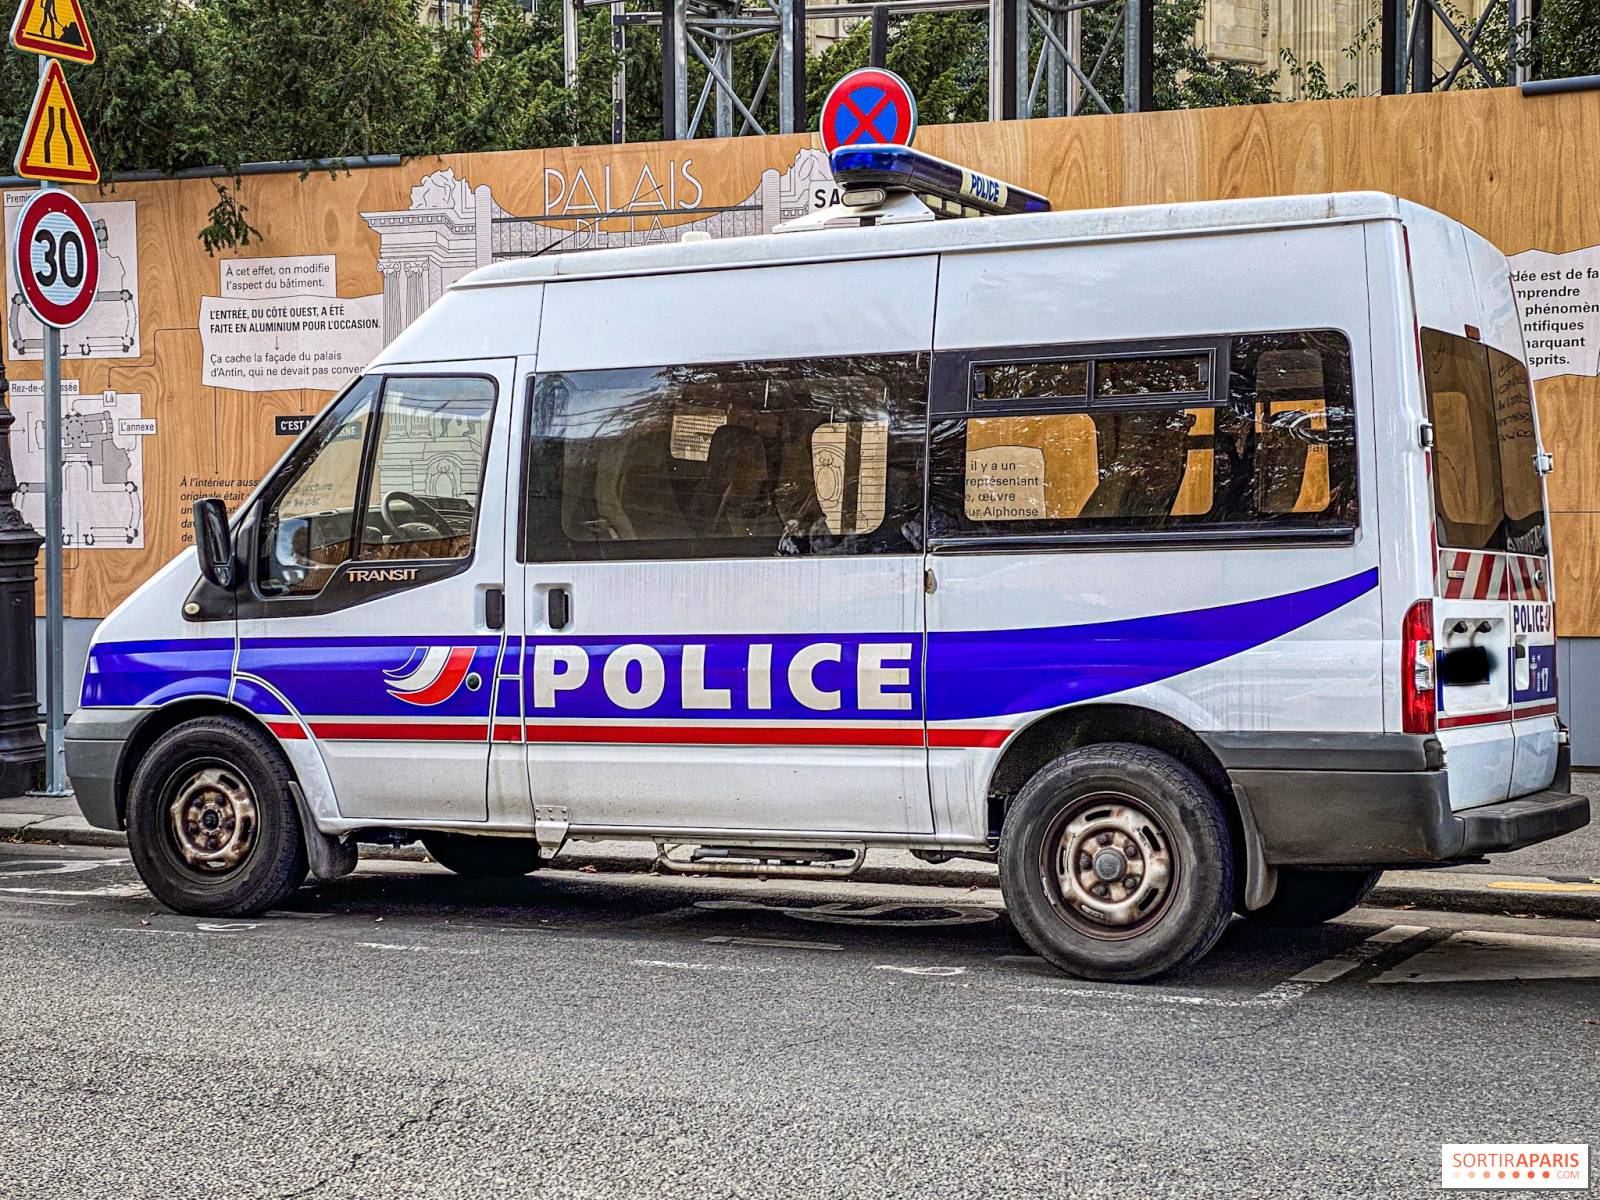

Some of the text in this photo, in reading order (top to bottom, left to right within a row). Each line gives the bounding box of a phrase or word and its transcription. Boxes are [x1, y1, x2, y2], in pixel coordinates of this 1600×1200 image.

[544, 159, 704, 216] PALAIS
[970, 173, 999, 203] POLICE
[576, 215, 670, 249] DE LA
[34, 229, 84, 288] 30
[226, 263, 330, 277] À cet effet, on modifie
[1541, 270, 1562, 281] est
[1566, 268, 1583, 280] de
[226, 278, 324, 292] l'aspect du bâtiment.
[210, 303, 344, 320] L'ENTRÉE, DU CÔTÉ OUEST, A ÉTÉ
[210, 319, 381, 334] FAITE EN ALUMINIUM POUR L'OCCASION.
[210, 351, 342, 366] Ça cache la façade du palais
[211, 367, 246, 378] d'Antin,
[248, 367, 264, 378] qui
[266, 368, 278, 376] ne
[280, 366, 310, 376] devait
[312, 367, 328, 378] pas
[105, 393, 115, 403] Là
[120, 422, 155, 432] L'annexe
[280, 420, 305, 431] C'EST
[970, 461, 1016, 472] il y a un
[180, 476, 187, 487] À
[190, 477, 234, 487] l'intérieur
[966, 476, 1039, 488] représentant
[223, 490, 244, 501] était
[983, 506, 1038, 518] Alphonse
[346, 568, 420, 582] TRANSIT
[1513, 604, 1544, 633] POLICE
[533, 642, 913, 711] POLICE
